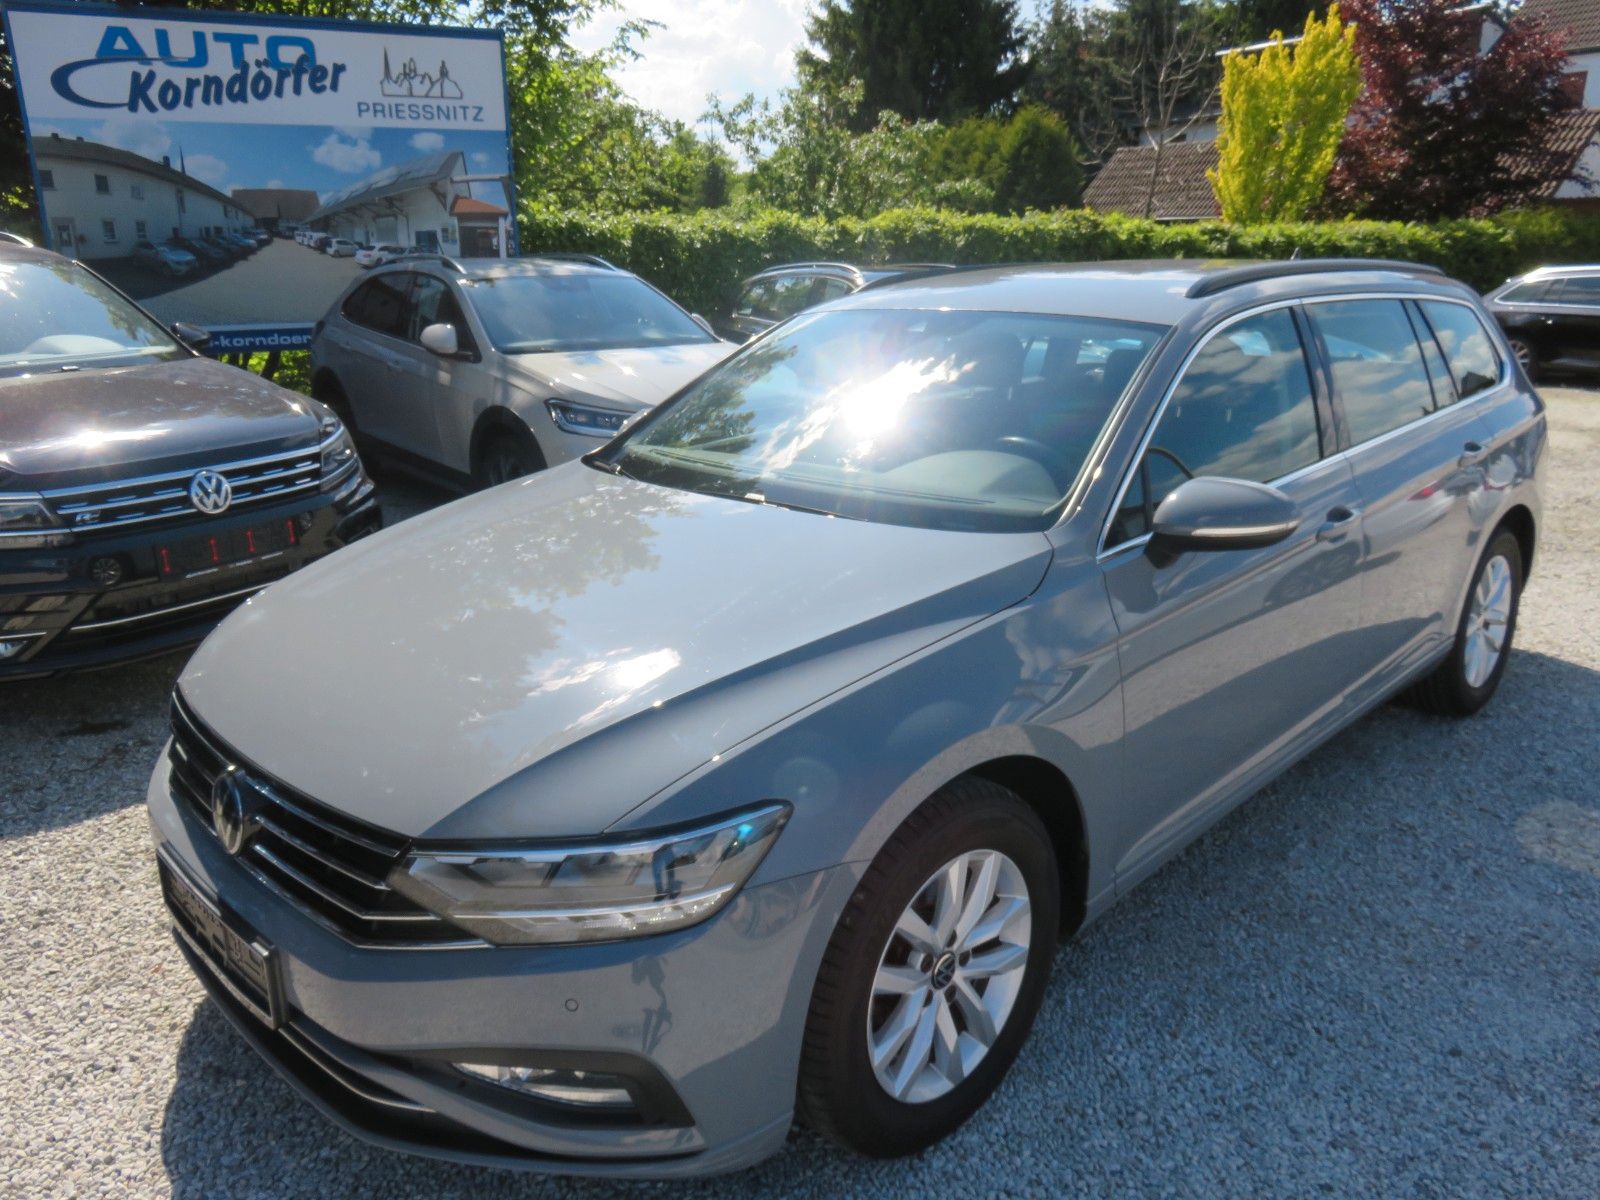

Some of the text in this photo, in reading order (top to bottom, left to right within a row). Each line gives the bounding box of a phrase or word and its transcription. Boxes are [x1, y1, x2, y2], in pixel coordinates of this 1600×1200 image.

[96, 26, 317, 70] AUTO
[128, 54, 346, 113] Korndörfer
[357, 102, 484, 122] PRIESSNITZ
